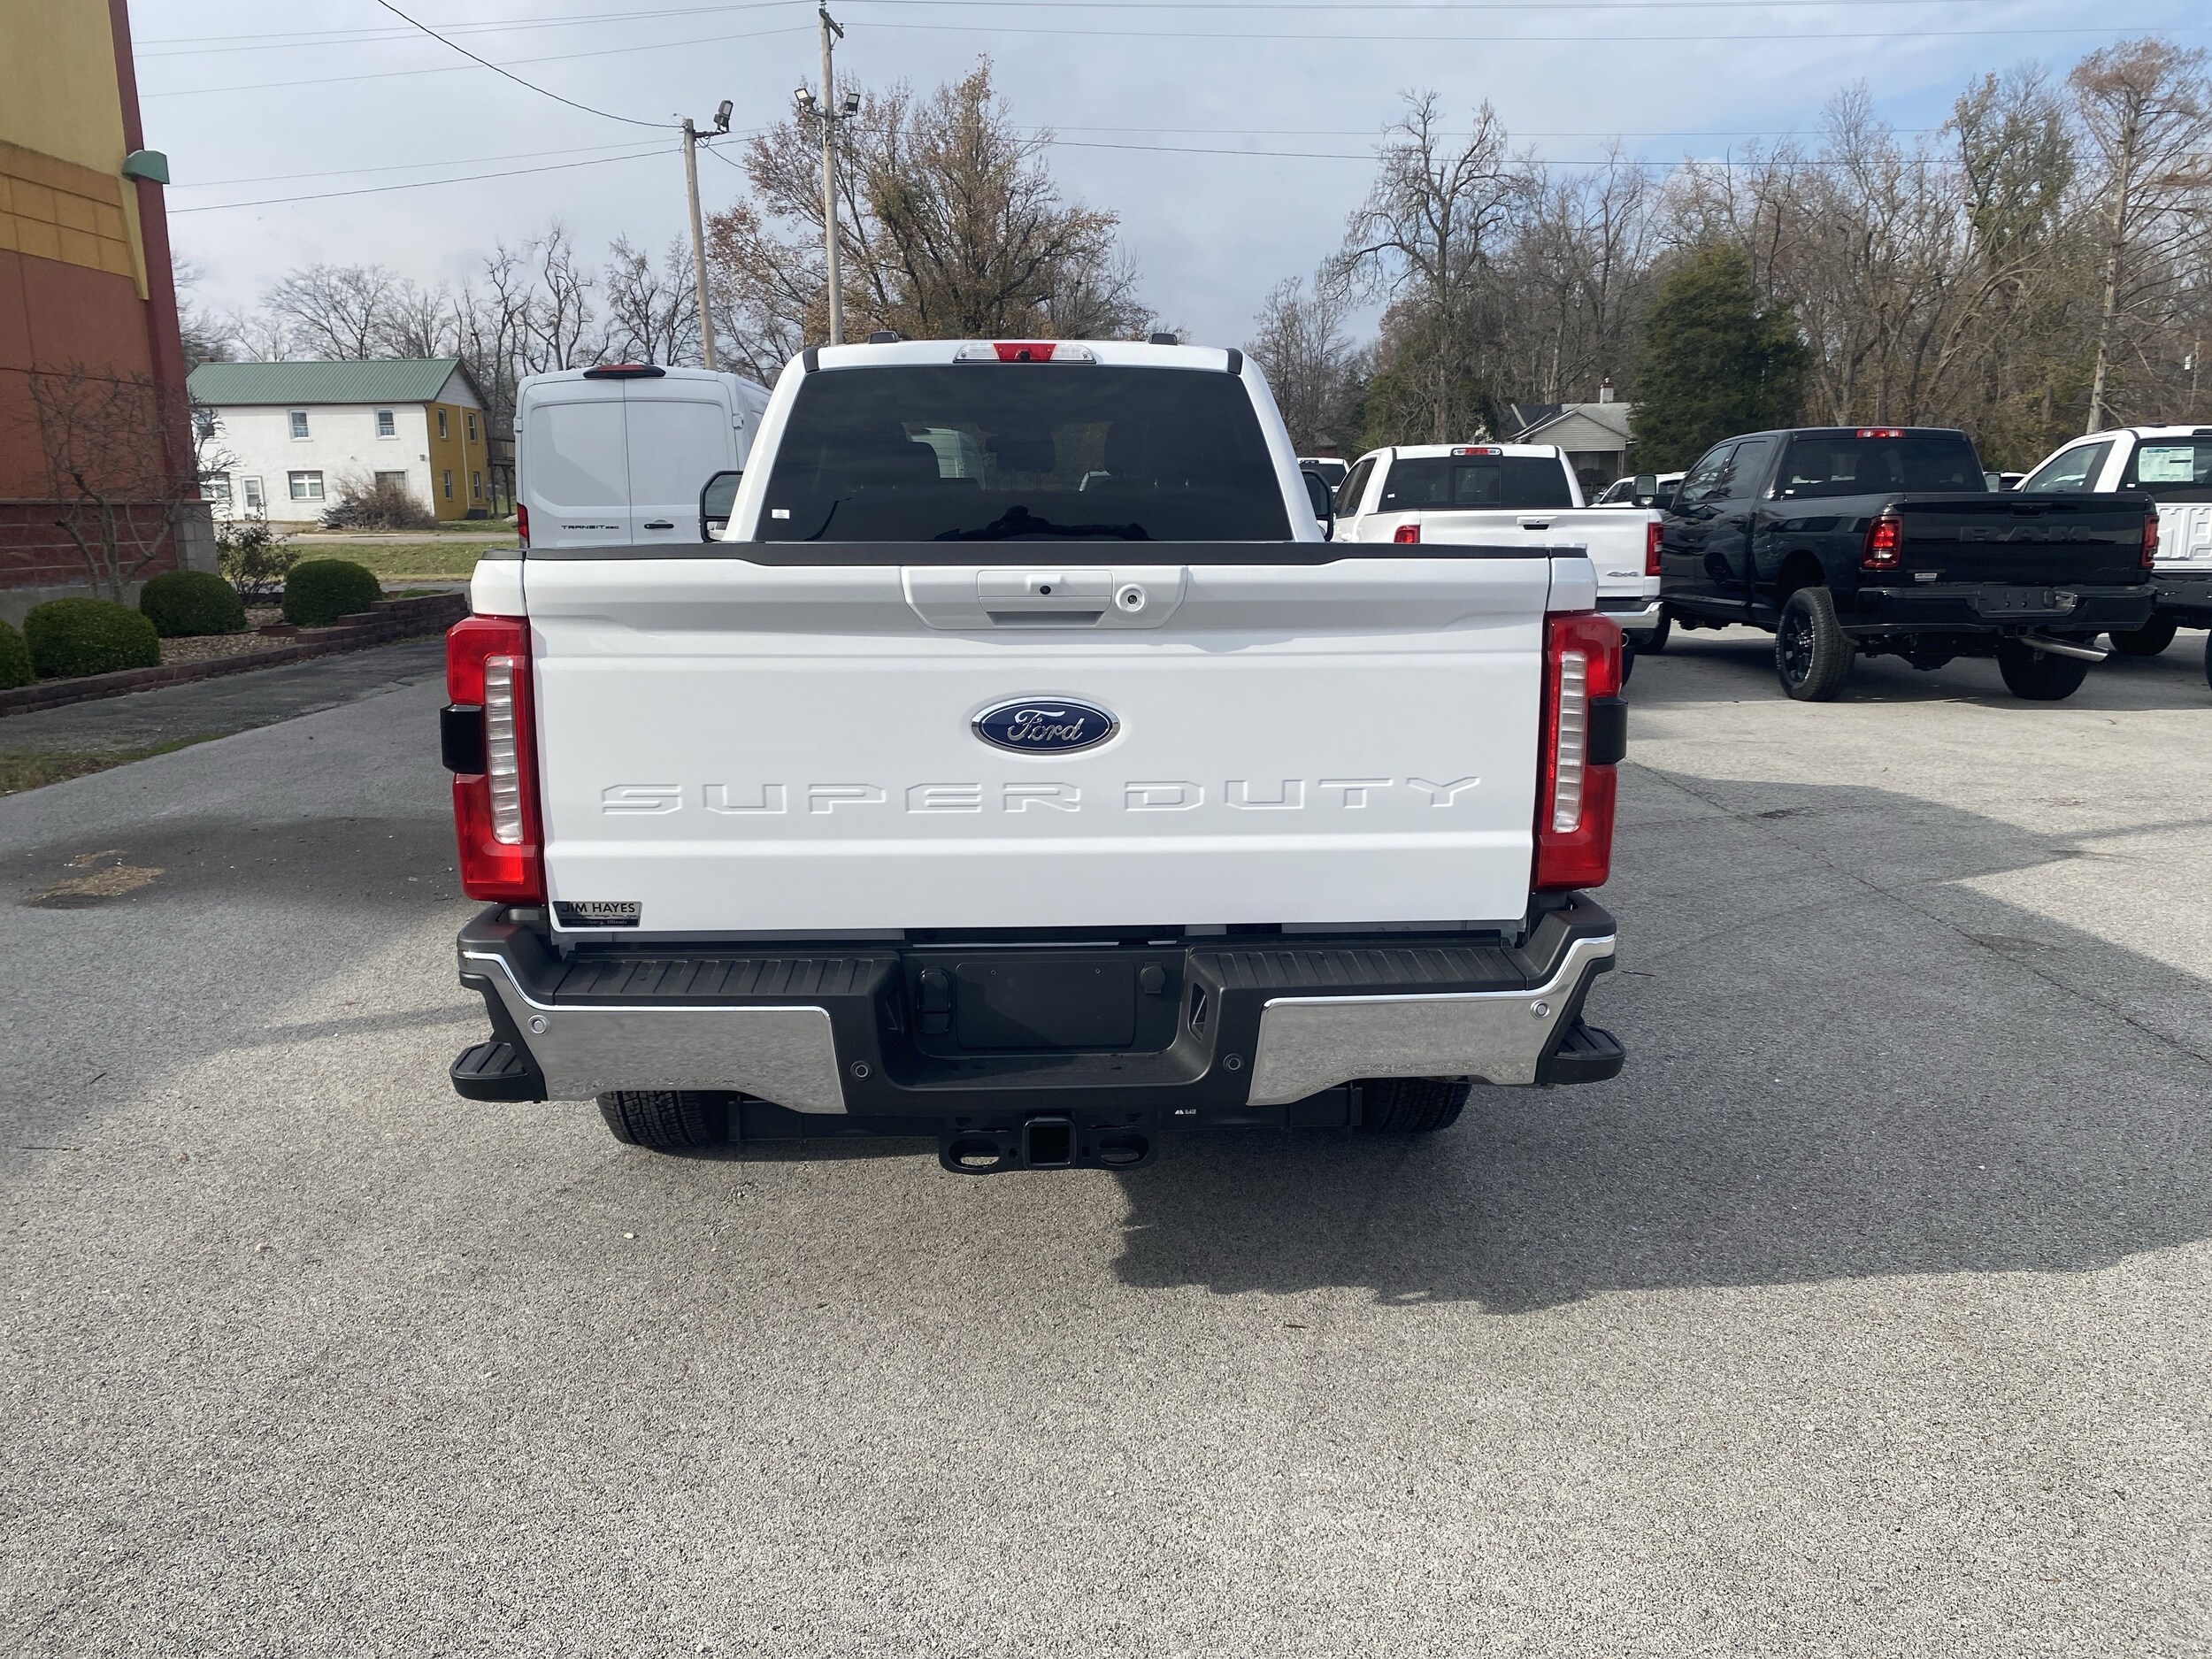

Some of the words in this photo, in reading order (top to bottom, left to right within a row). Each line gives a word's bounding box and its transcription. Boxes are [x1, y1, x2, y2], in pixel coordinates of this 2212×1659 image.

[1958, 526, 2092, 542] RAM
[1006, 709, 1086, 742] Ford
[602, 781, 1081, 815] SUPER
[1124, 776, 1482, 811] DUTY
[561, 902, 588, 913] JIM
[592, 902, 635, 913] HAYES
